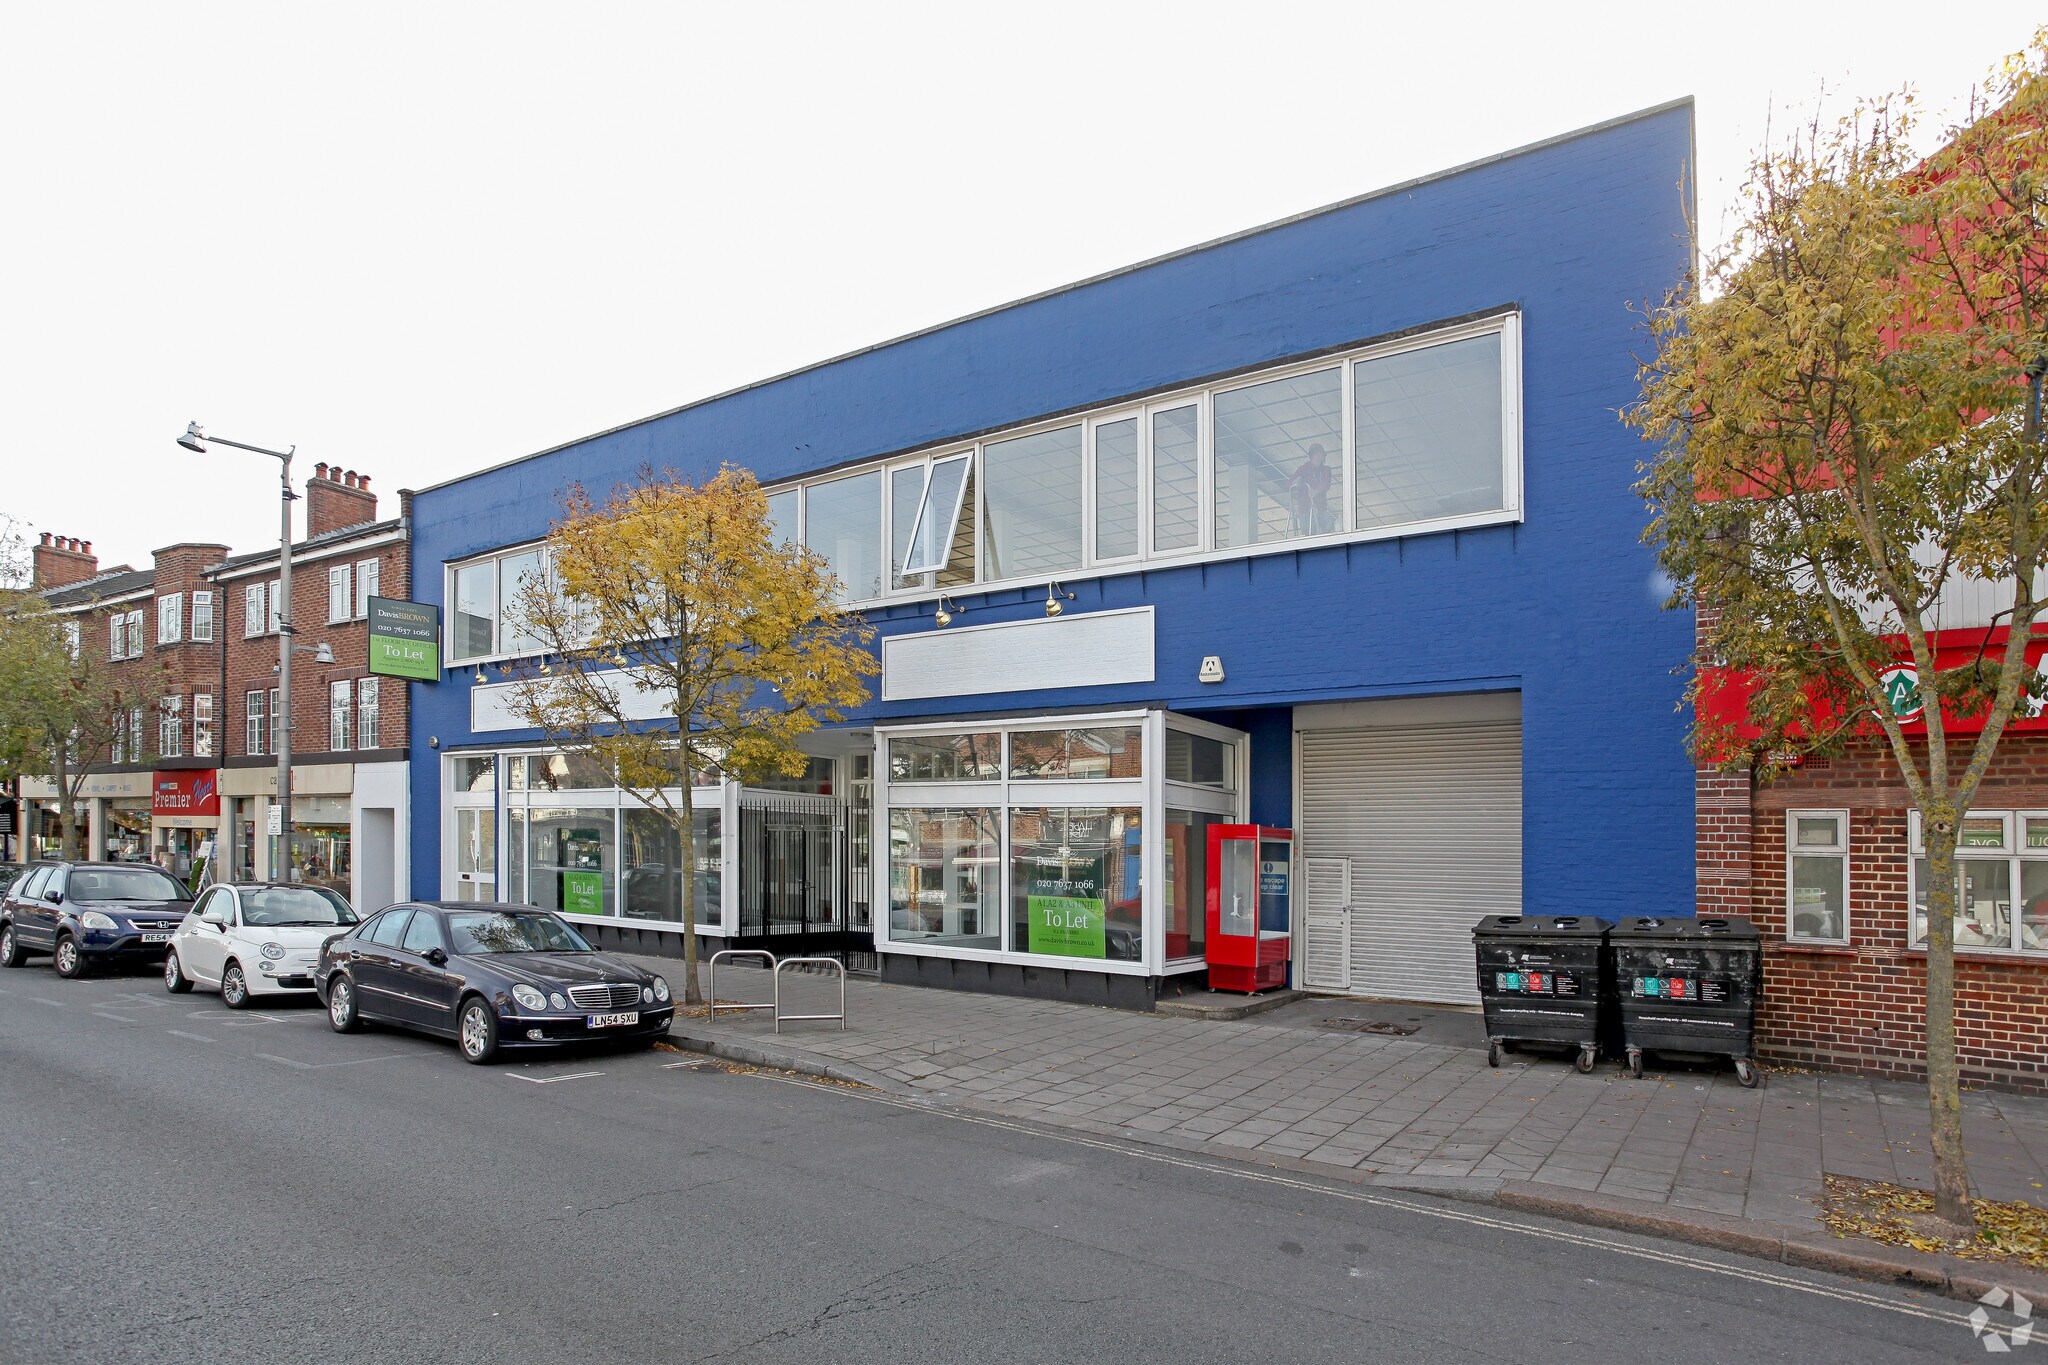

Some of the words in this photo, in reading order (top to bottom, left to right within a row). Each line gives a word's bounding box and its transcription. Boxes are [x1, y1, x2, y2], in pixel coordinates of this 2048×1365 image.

[377, 609, 430, 623] DavisBROWN
[393, 626, 411, 636] 7637
[413, 629, 430, 637] 1066
[381, 637, 400, 645] FLOOR
[382, 644, 400, 657] To
[404, 646, 424, 660] Let
[154, 790, 191, 808] Premier
[571, 881, 582, 894] To
[583, 882, 595, 895] Let
[1036, 880, 1052, 888] 020
[1053, 878, 1073, 891] 7637
[1074, 879, 1094, 890] 1066
[1058, 900, 1064, 908] &
[1065, 900, 1075, 909] A3
[1076, 901, 1095, 910] UNIT
[1043, 909, 1062, 927] To
[1065, 911, 1088, 929] Let
[1037, 937, 1096, 947] www.davis-brown.co.uk
[594, 1015, 619, 1026] LN54
[620, 1013, 637, 1024] SXU
